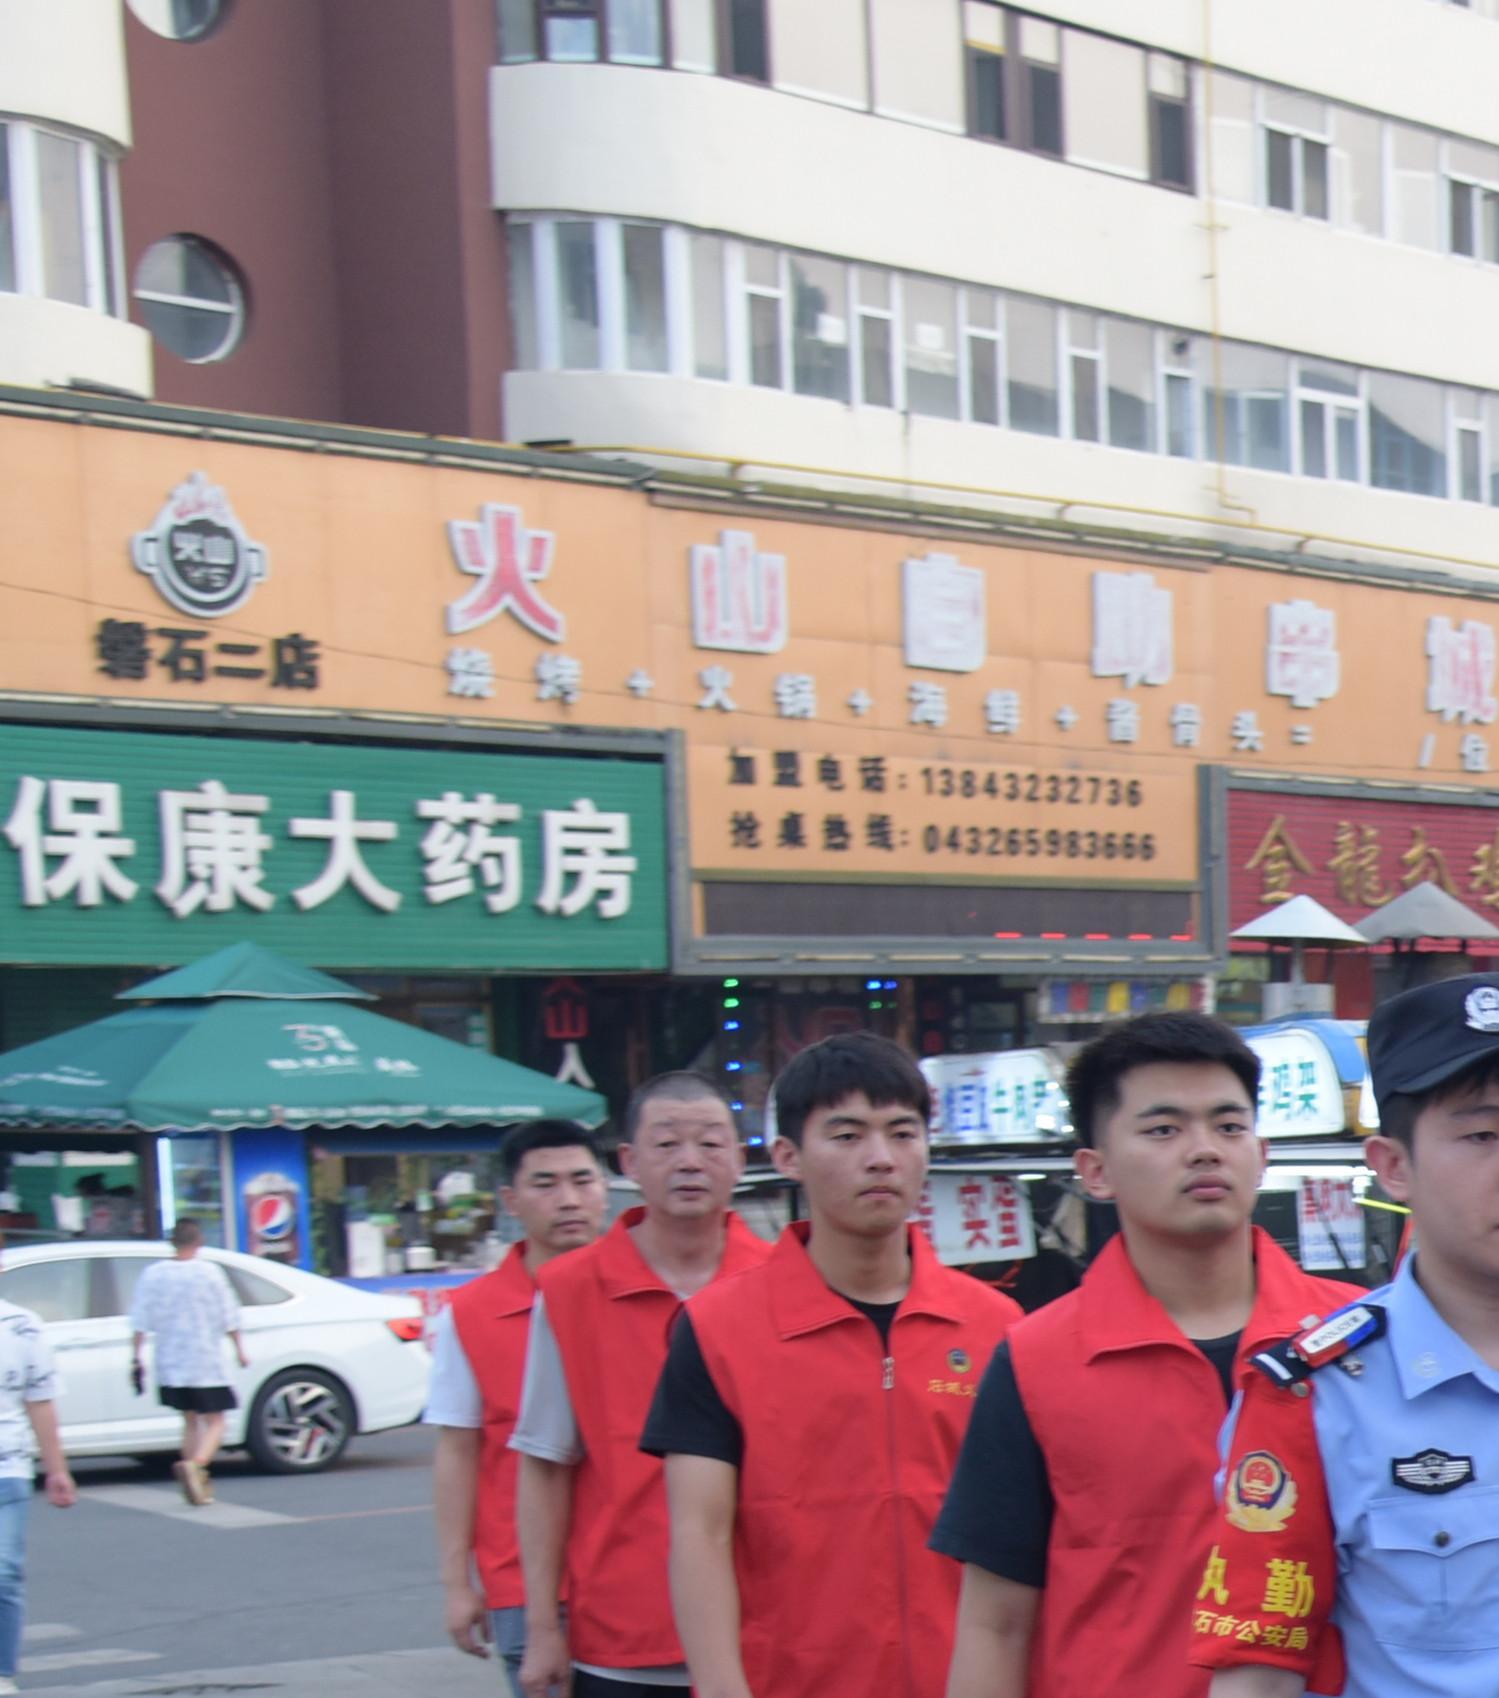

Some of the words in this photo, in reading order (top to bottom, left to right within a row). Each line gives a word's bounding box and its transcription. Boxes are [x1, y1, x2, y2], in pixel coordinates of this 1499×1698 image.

[5, 775, 637, 919] 保康大药房
